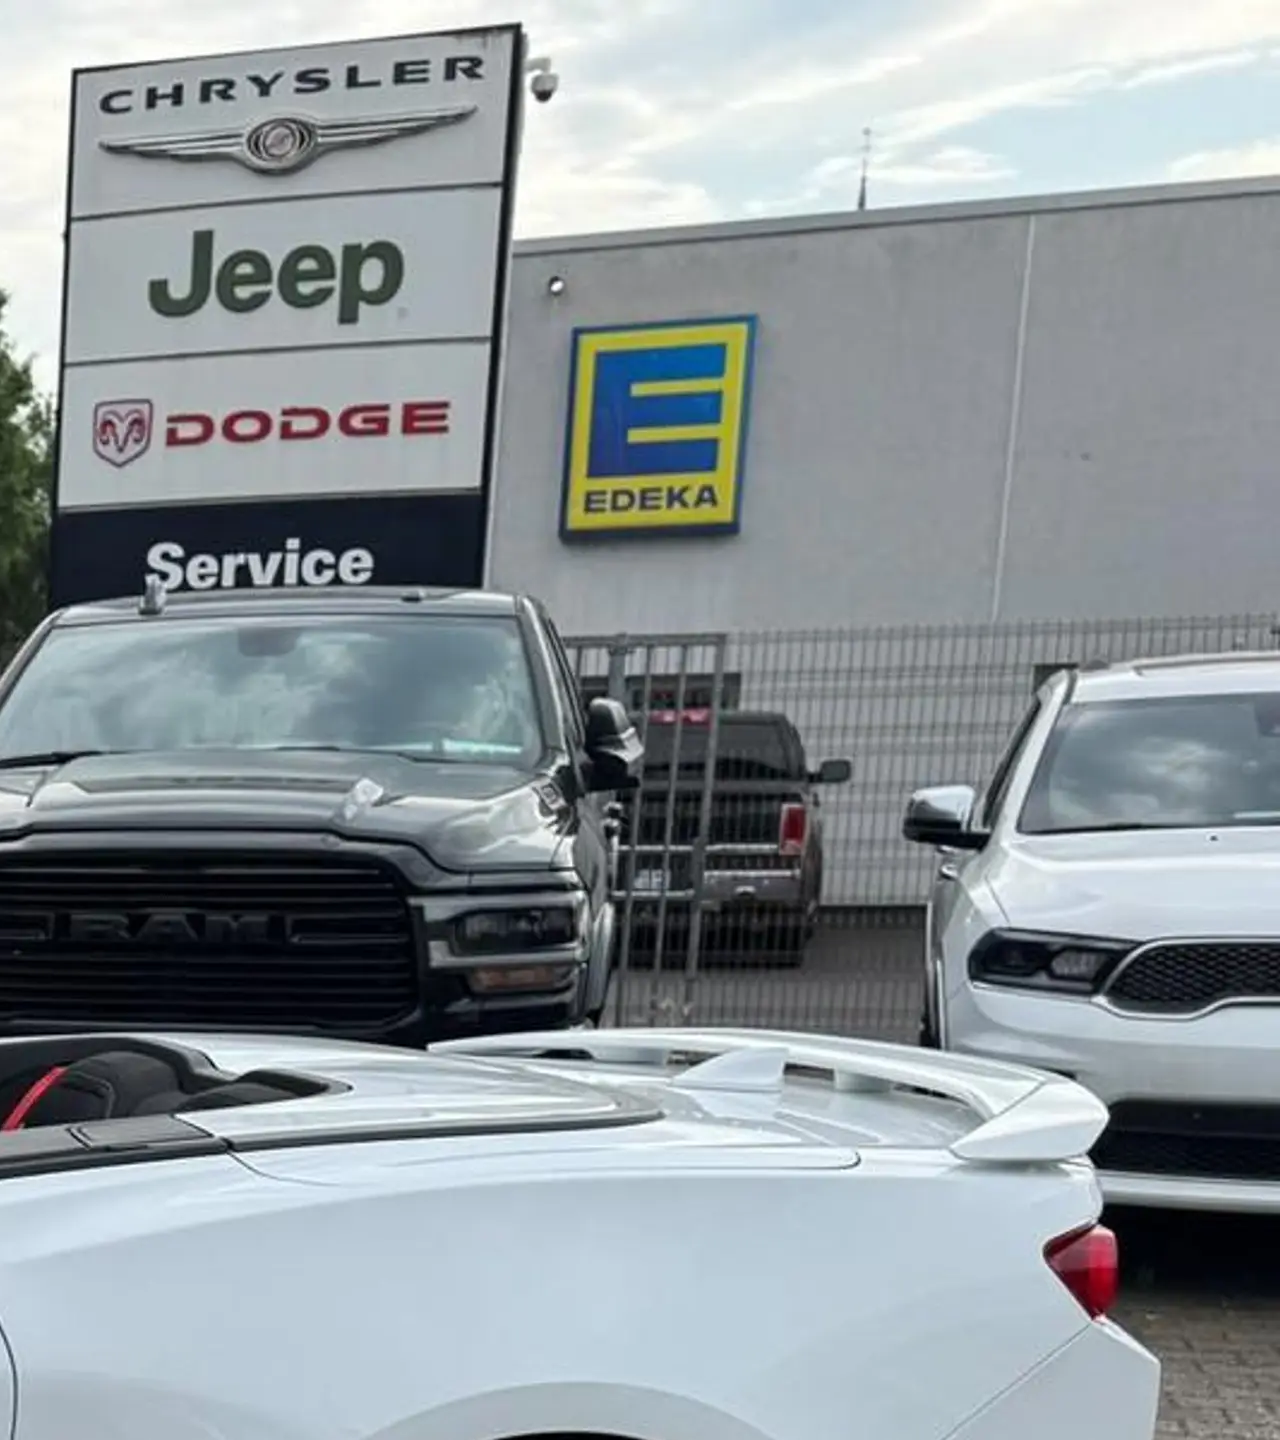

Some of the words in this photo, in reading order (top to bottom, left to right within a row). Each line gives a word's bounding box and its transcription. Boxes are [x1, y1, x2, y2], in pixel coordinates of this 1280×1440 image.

[99, 55, 485, 115] CHRYSLER
[148, 229, 405, 325] Jeep
[165, 401, 450, 447] DODGE
[583, 484, 719, 514] EDEKA
[146, 537, 375, 592] Service
[69, 910, 269, 943] RAM
